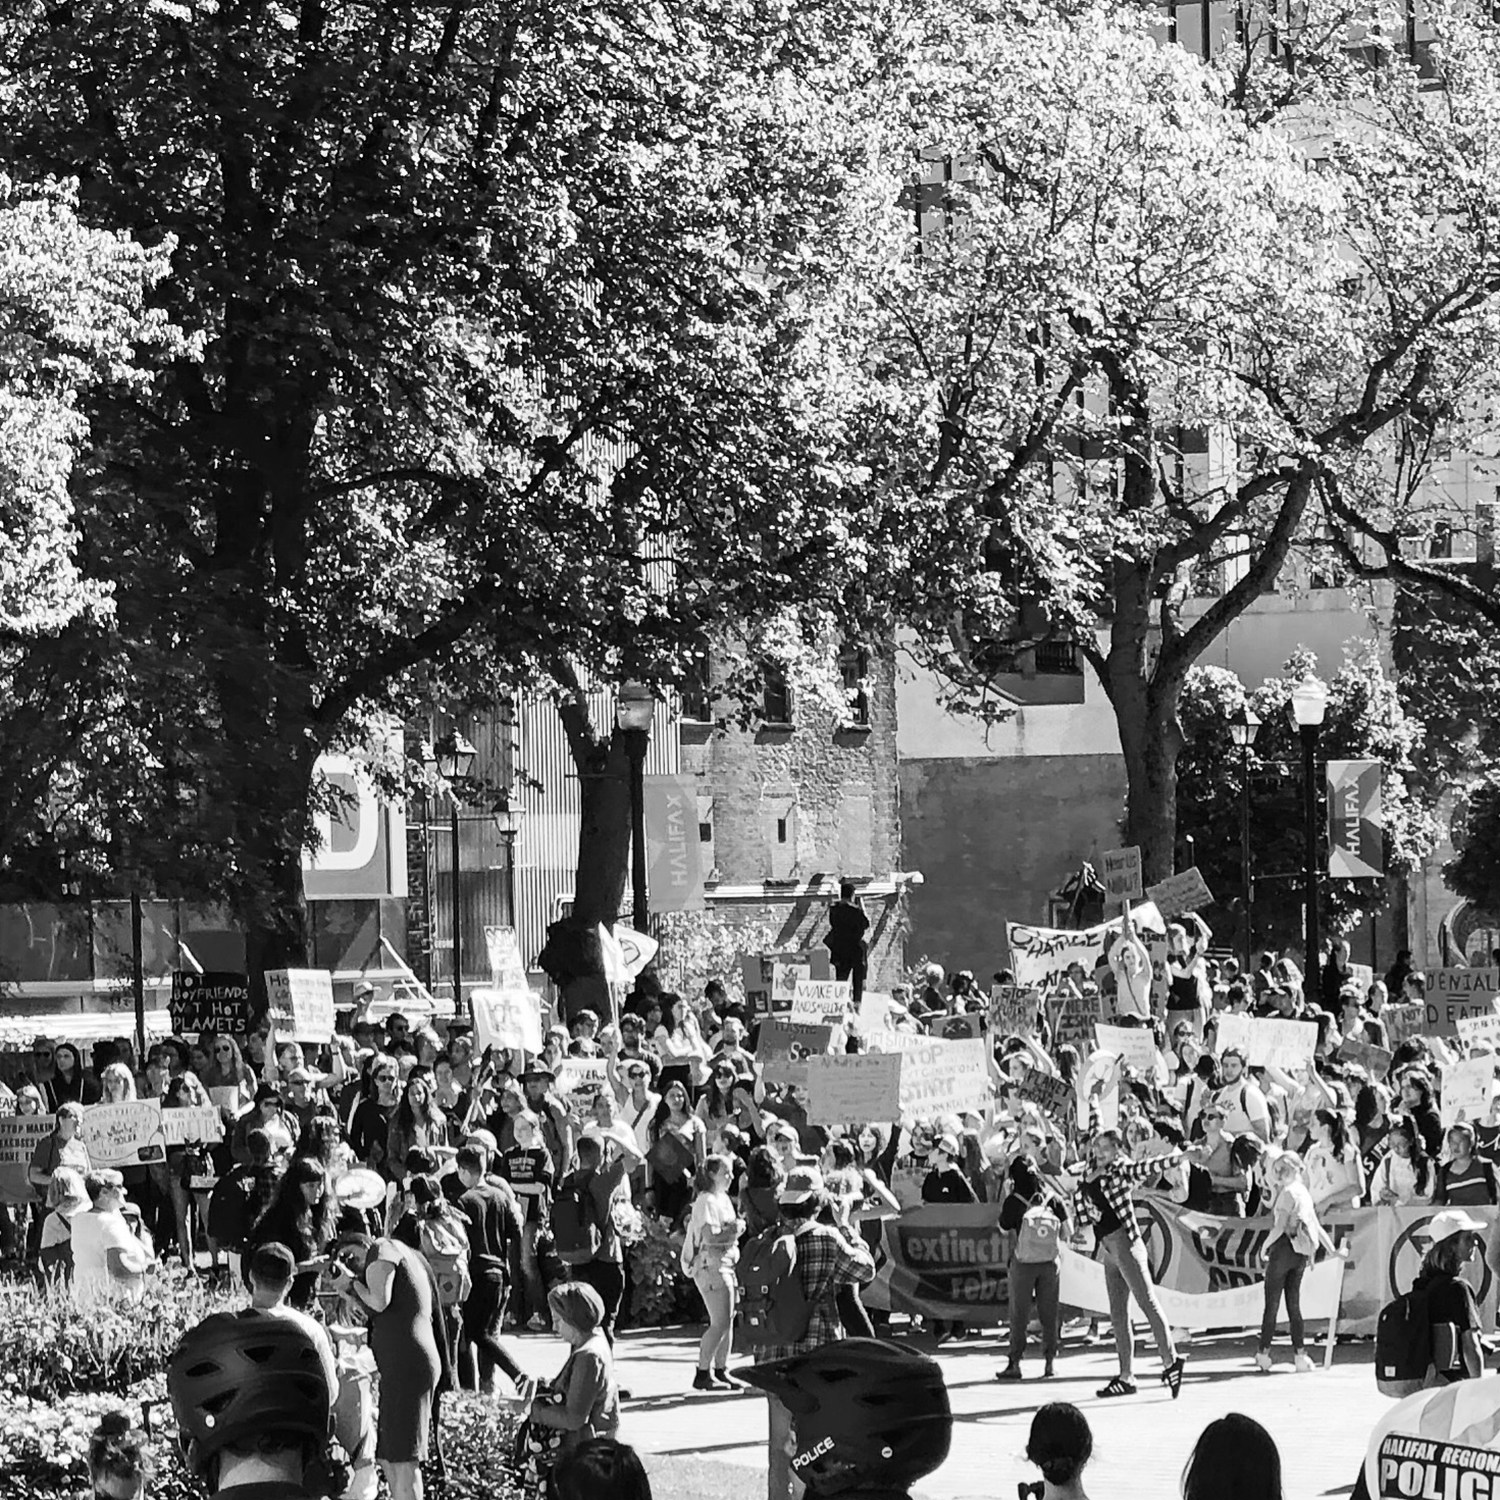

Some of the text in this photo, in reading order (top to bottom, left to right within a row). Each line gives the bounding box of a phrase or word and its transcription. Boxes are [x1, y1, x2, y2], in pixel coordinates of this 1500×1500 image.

[1345, 776, 1360, 855] HALIFAX
[667, 794, 688, 886] HALIFAX
[797, 984, 847, 999] WAKE UP
[1426, 974, 1497, 992] DENIAL
[173, 1018, 246, 1032] PLANETS
[26, 1122, 56, 1134] MAKIN
[792, 1436, 835, 1471] POLICE
[1382, 1438, 1438, 1461] HALIFAX
